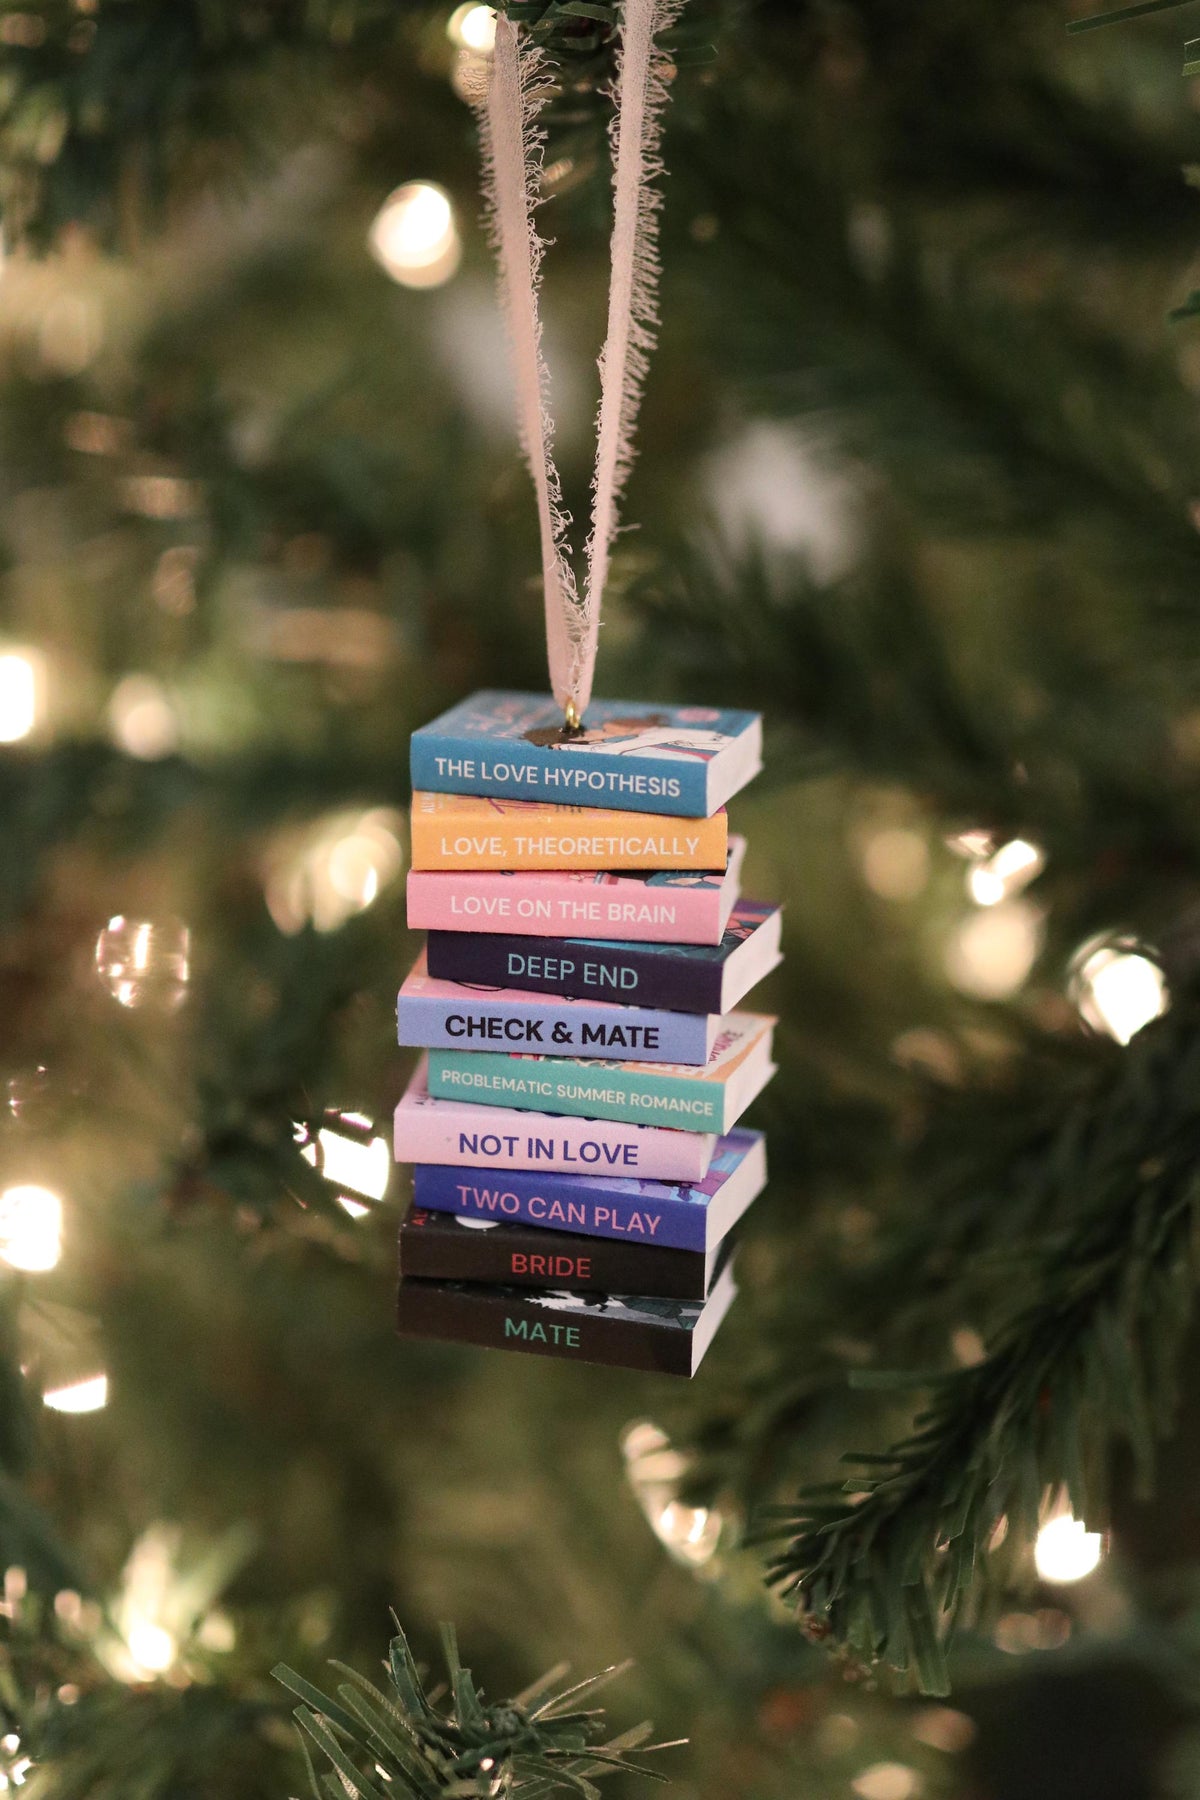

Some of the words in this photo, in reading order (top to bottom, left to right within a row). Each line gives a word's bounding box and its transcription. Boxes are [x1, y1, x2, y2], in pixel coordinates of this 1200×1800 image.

[434, 757, 476, 779] THE
[480, 761, 538, 784] LOVE
[543, 768, 681, 797] HYPOTHESIS
[441, 837, 507, 858] LOVE,
[516, 837, 700, 856] THEORETICALLY
[451, 896, 511, 916] LOVE
[517, 899, 551, 918] ON
[557, 901, 601, 920] THE
[607, 903, 676, 924] BRAIN
[507, 954, 576, 981] DEEP
[584, 962, 639, 989] END
[444, 1014, 544, 1042] CHECK
[551, 1022, 574, 1043] &
[581, 1024, 660, 1049] MATE
[441, 1070, 553, 1095] PROBLEMATIC
[557, 1084, 626, 1104] SUMMER
[630, 1093, 713, 1116] ROMANCE
[459, 1133, 520, 1156] NOT
[527, 1138, 554, 1159] IN
[562, 1140, 639, 1165] LOVE
[456, 1186, 520, 1214] TWO
[528, 1197, 588, 1225] CAN
[594, 1207, 662, 1236] PLAY
[511, 1253, 591, 1278] BRIDE
[504, 1318, 580, 1348] MATE
